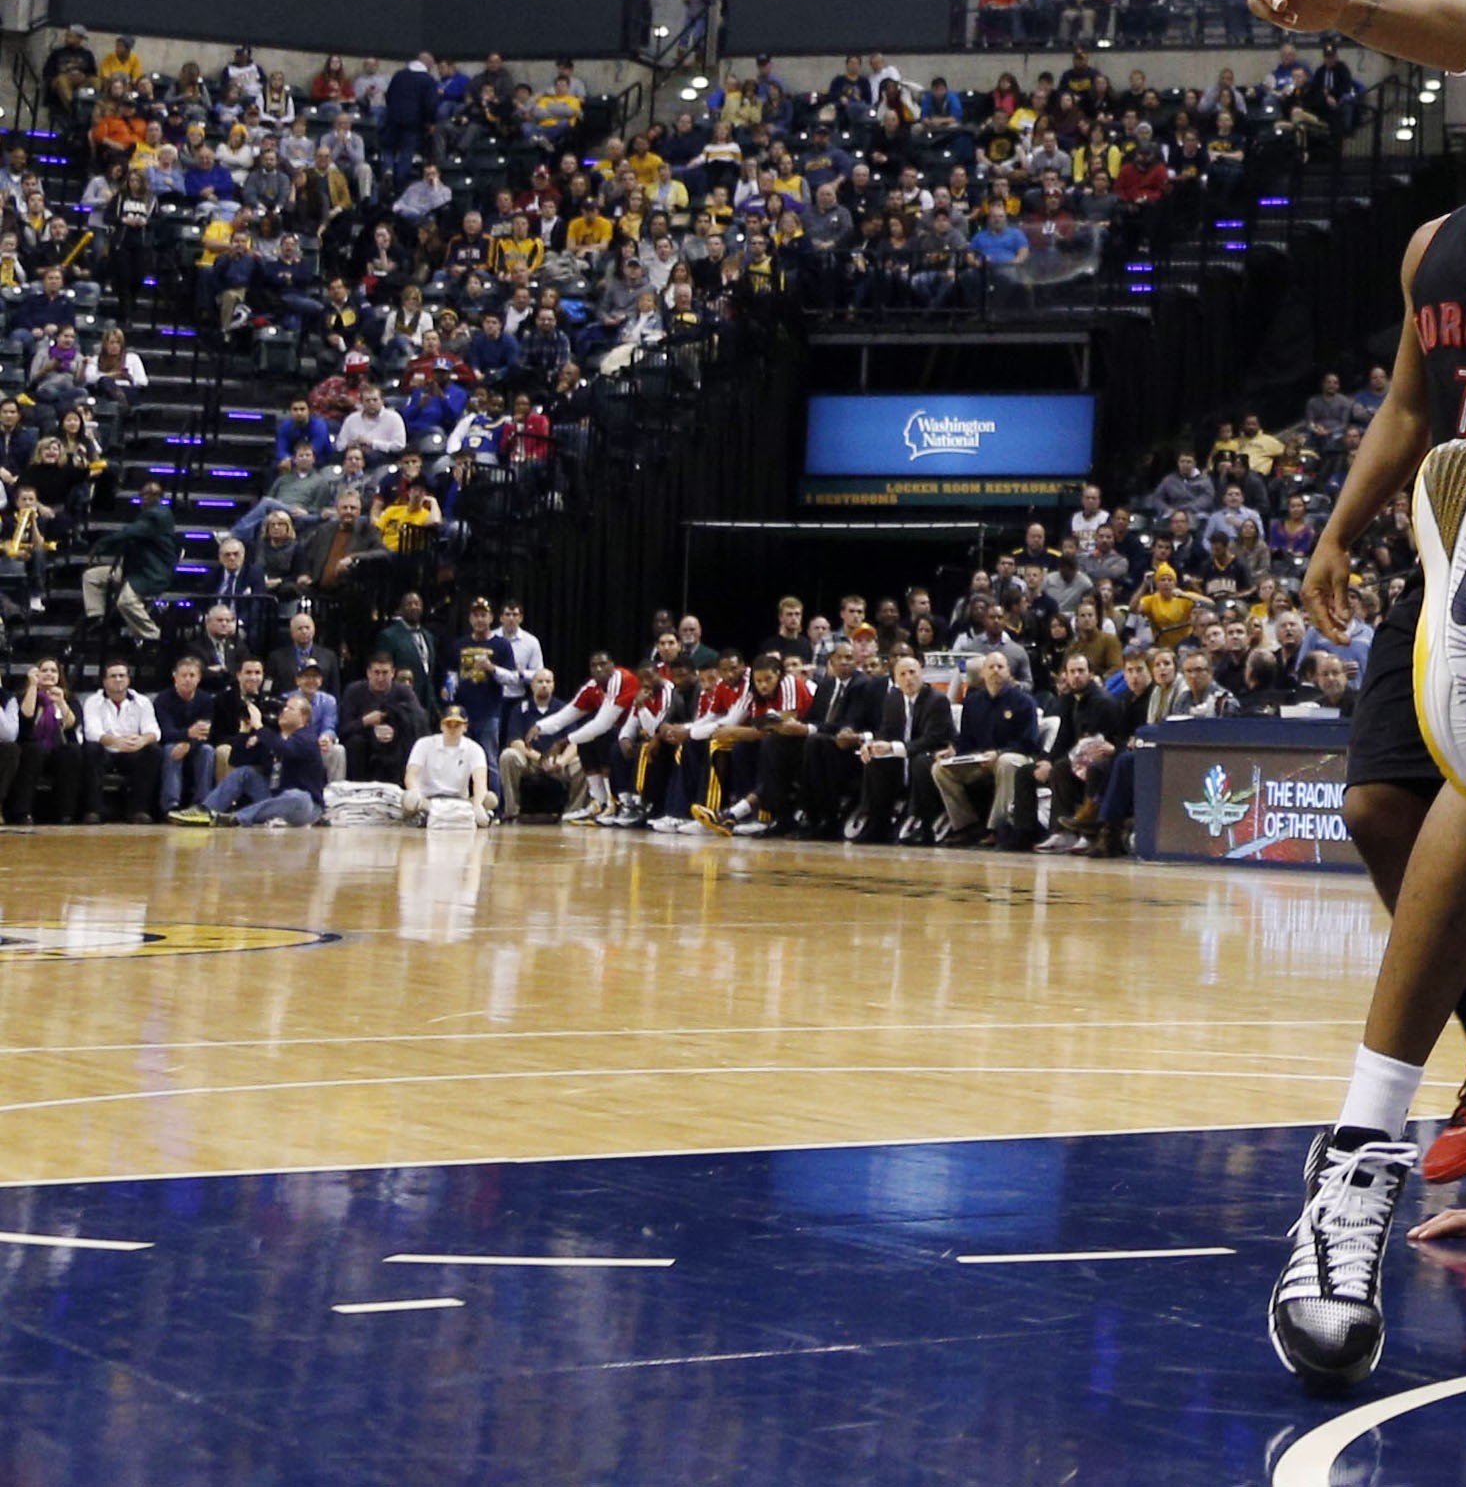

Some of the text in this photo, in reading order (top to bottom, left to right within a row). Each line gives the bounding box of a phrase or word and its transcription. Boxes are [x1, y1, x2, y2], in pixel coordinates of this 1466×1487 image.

[917, 417, 996, 435] Washington
[922, 433, 979, 448] National
[1265, 780, 1295, 808] THE
[1264, 812, 1286, 839] OF
[1286, 813, 1316, 840] THE
